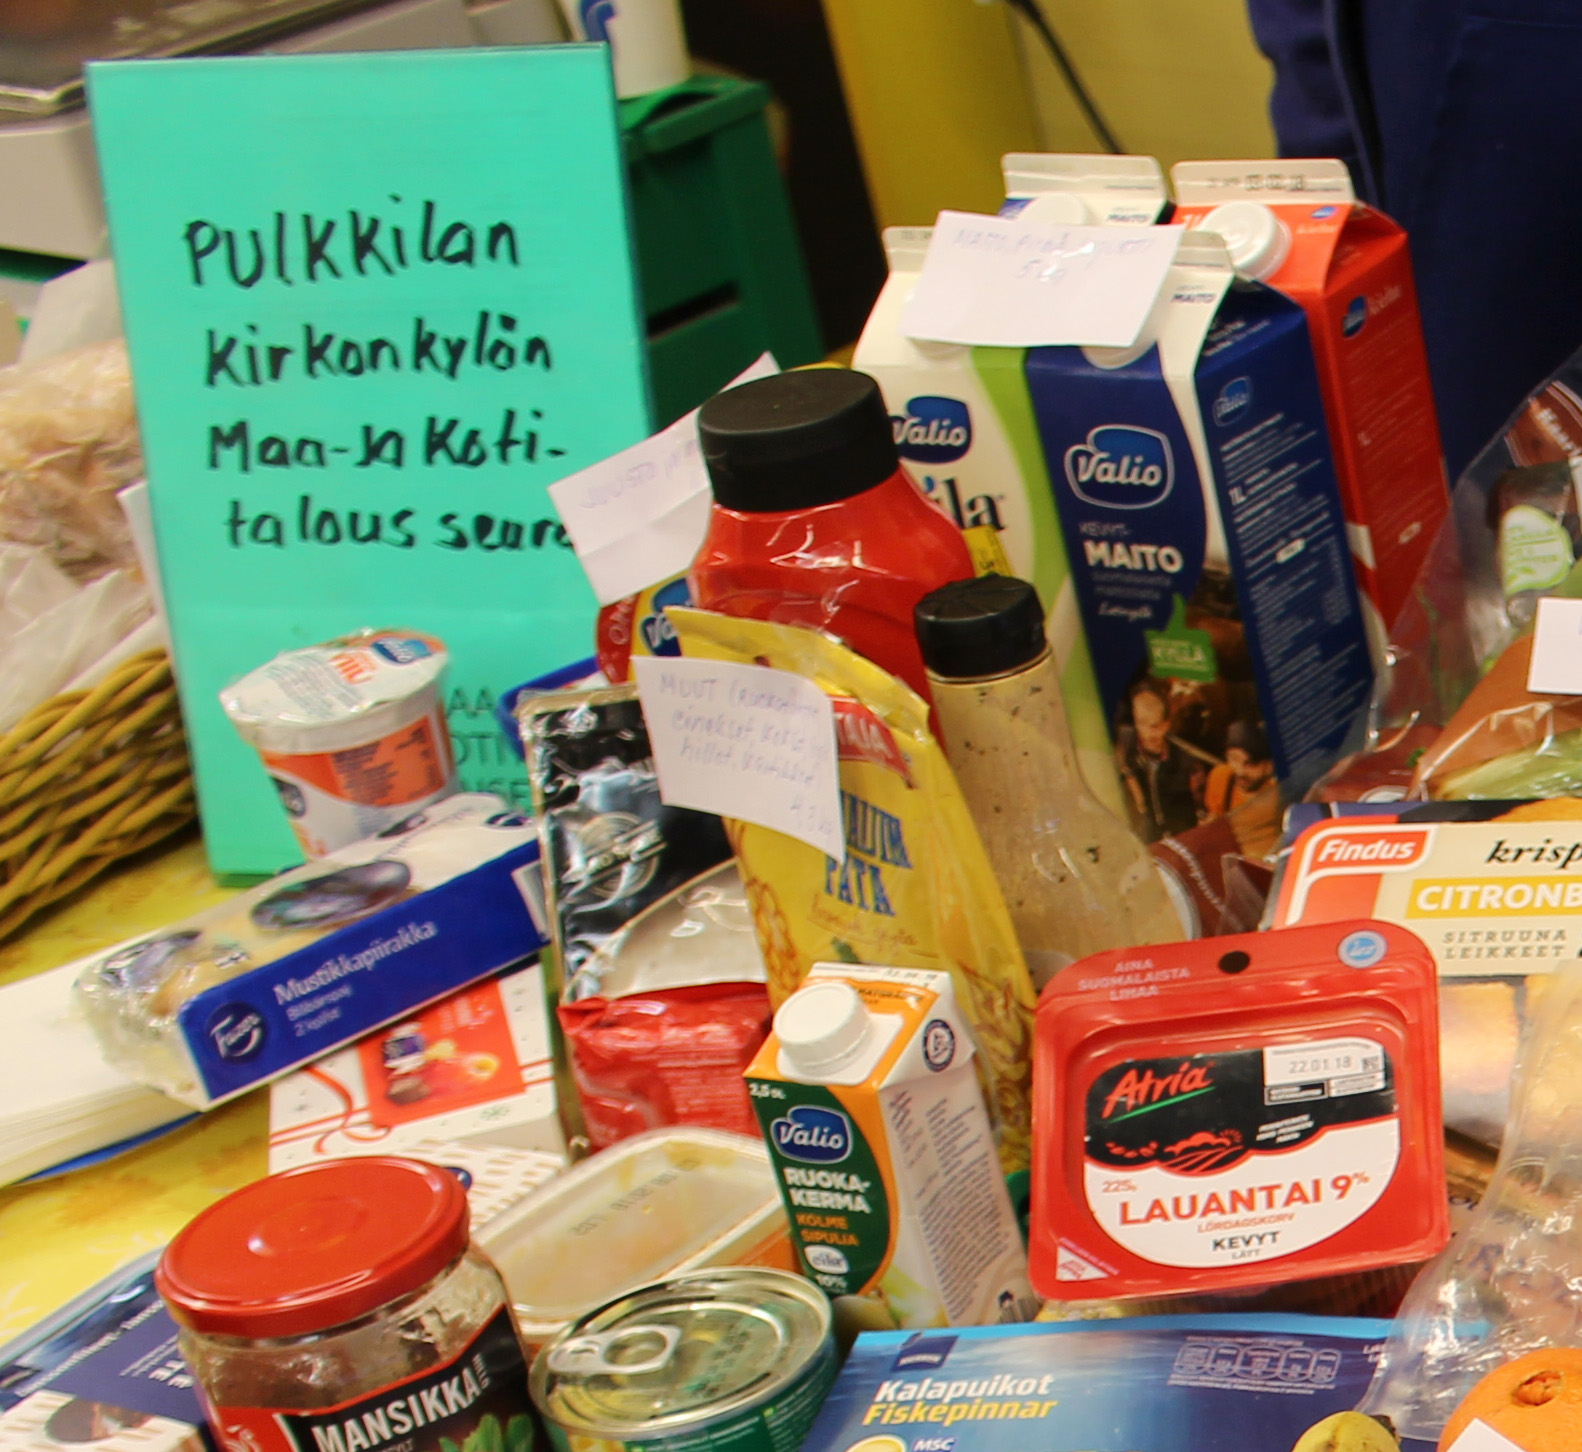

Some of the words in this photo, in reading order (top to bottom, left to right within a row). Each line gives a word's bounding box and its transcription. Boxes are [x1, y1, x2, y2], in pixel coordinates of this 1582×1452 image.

[1077, 452, 1163, 487] Valio
[1083, 539, 1185, 574] MAITO
[1316, 837, 1416, 864] Findus
[1443, 929, 1567, 945] SITRUUNA
[272, 918, 437, 1007] Mustikkapiirakka
[1444, 944, 1566, 959] LEIKKEET
[1114, 958, 1155, 973] AINA
[1077, 967, 1191, 992] SUOMALAISTA
[1109, 985, 1160, 1001] LIHAA
[1101, 1061, 1214, 1120] Atria
[779, 1122, 845, 1149] Valio
[783, 1167, 872, 1193] RUOKA-
[788, 1188, 872, 1214] KERMA
[1119, 1177, 1324, 1226] LAUANTAI
[796, 1212, 849, 1230] KOLME
[1211, 1230, 1281, 1252] KEVYT
[875, 1372, 1055, 1405] Kalapuikot
[861, 1397, 1059, 1427] Fiskepinnar
[914, 1436, 956, 1452] MSC
